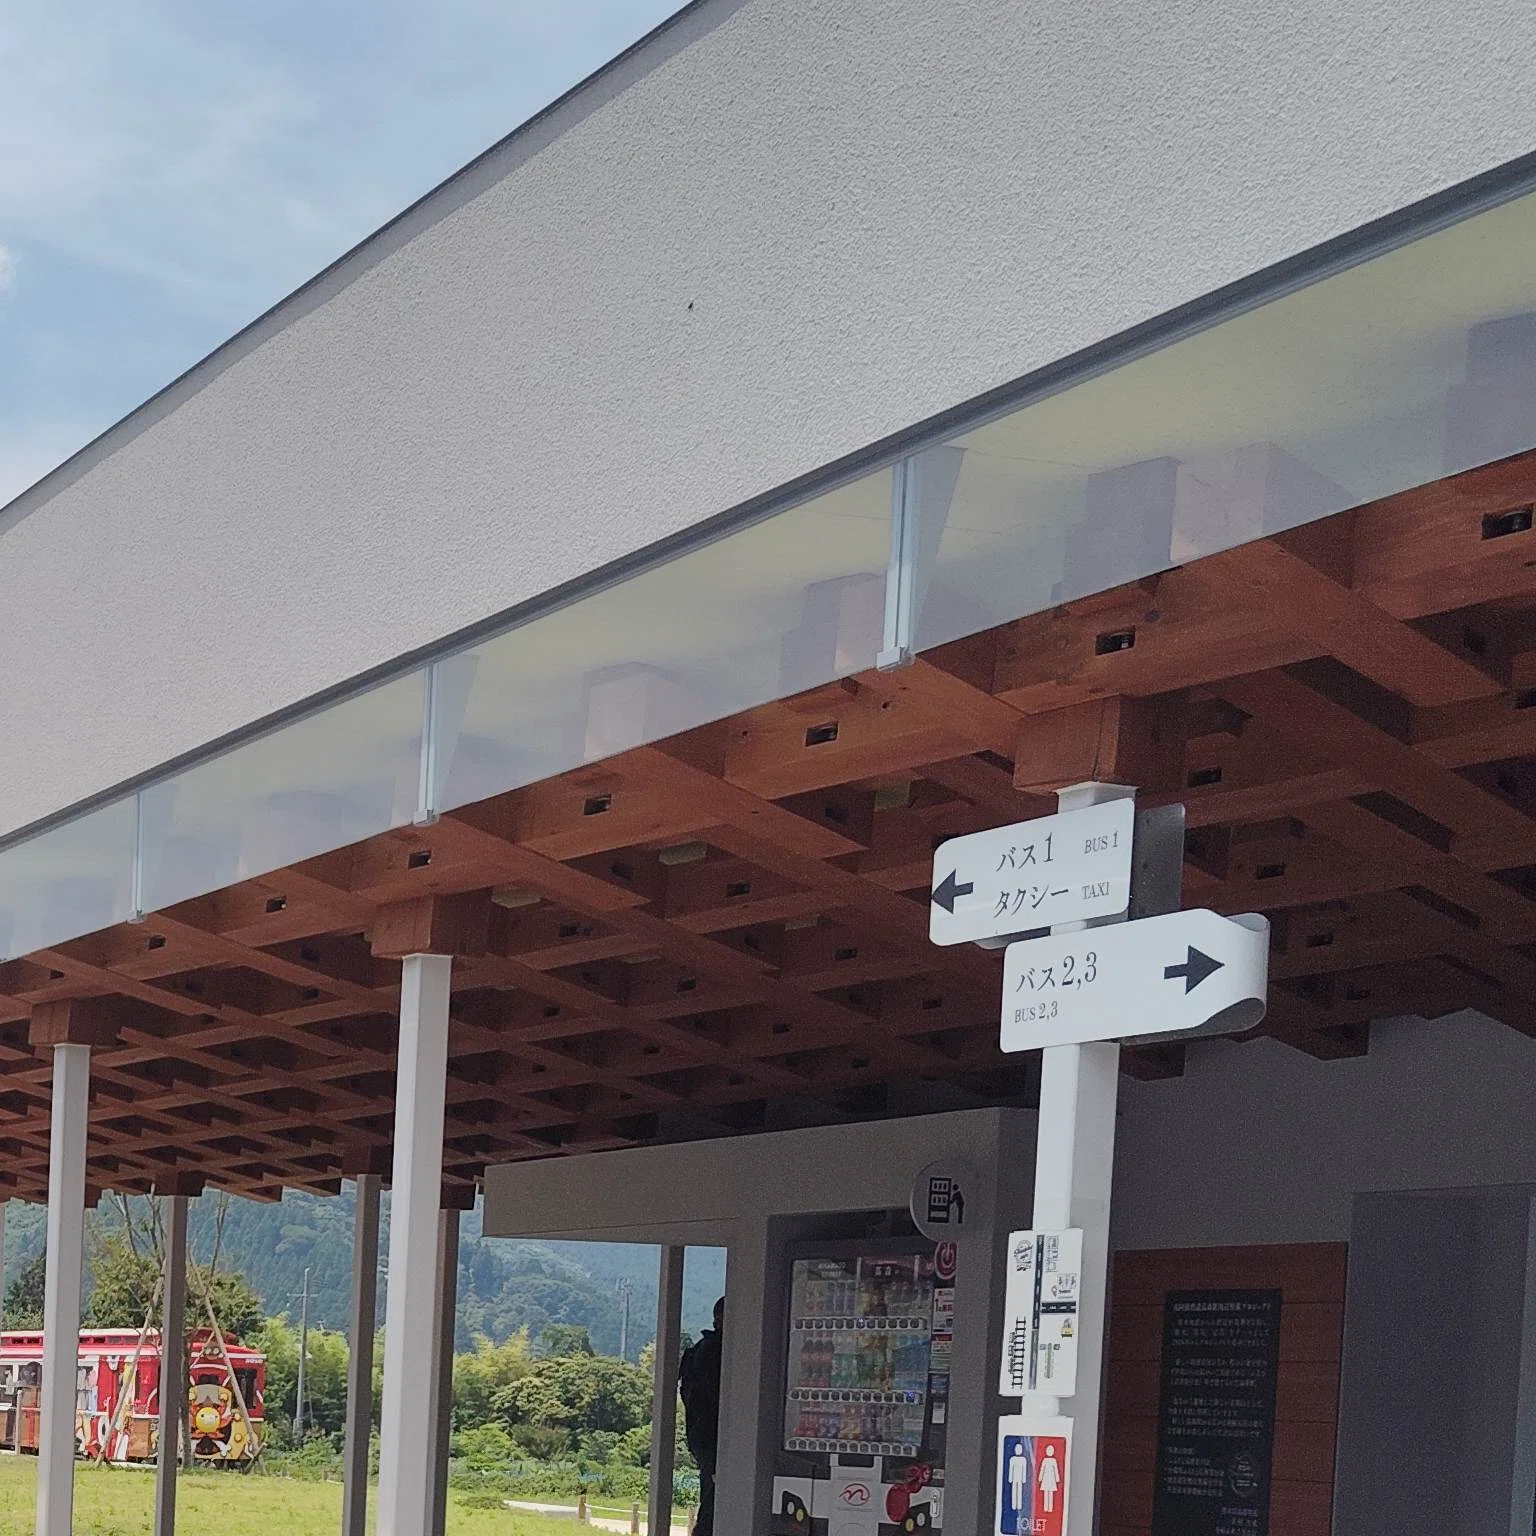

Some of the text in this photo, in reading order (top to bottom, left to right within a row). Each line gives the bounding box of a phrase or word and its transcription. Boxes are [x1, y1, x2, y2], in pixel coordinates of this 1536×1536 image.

[995, 832, 1054, 872] バス1
[1083, 831, 1119, 854] BUS 1
[992, 883, 1069, 918] タクシー
[1081, 881, 1110, 900] TAXI
[1015, 951, 1097, 992] バス2,3
[1014, 1000, 1059, 1023] BUS 2,3
